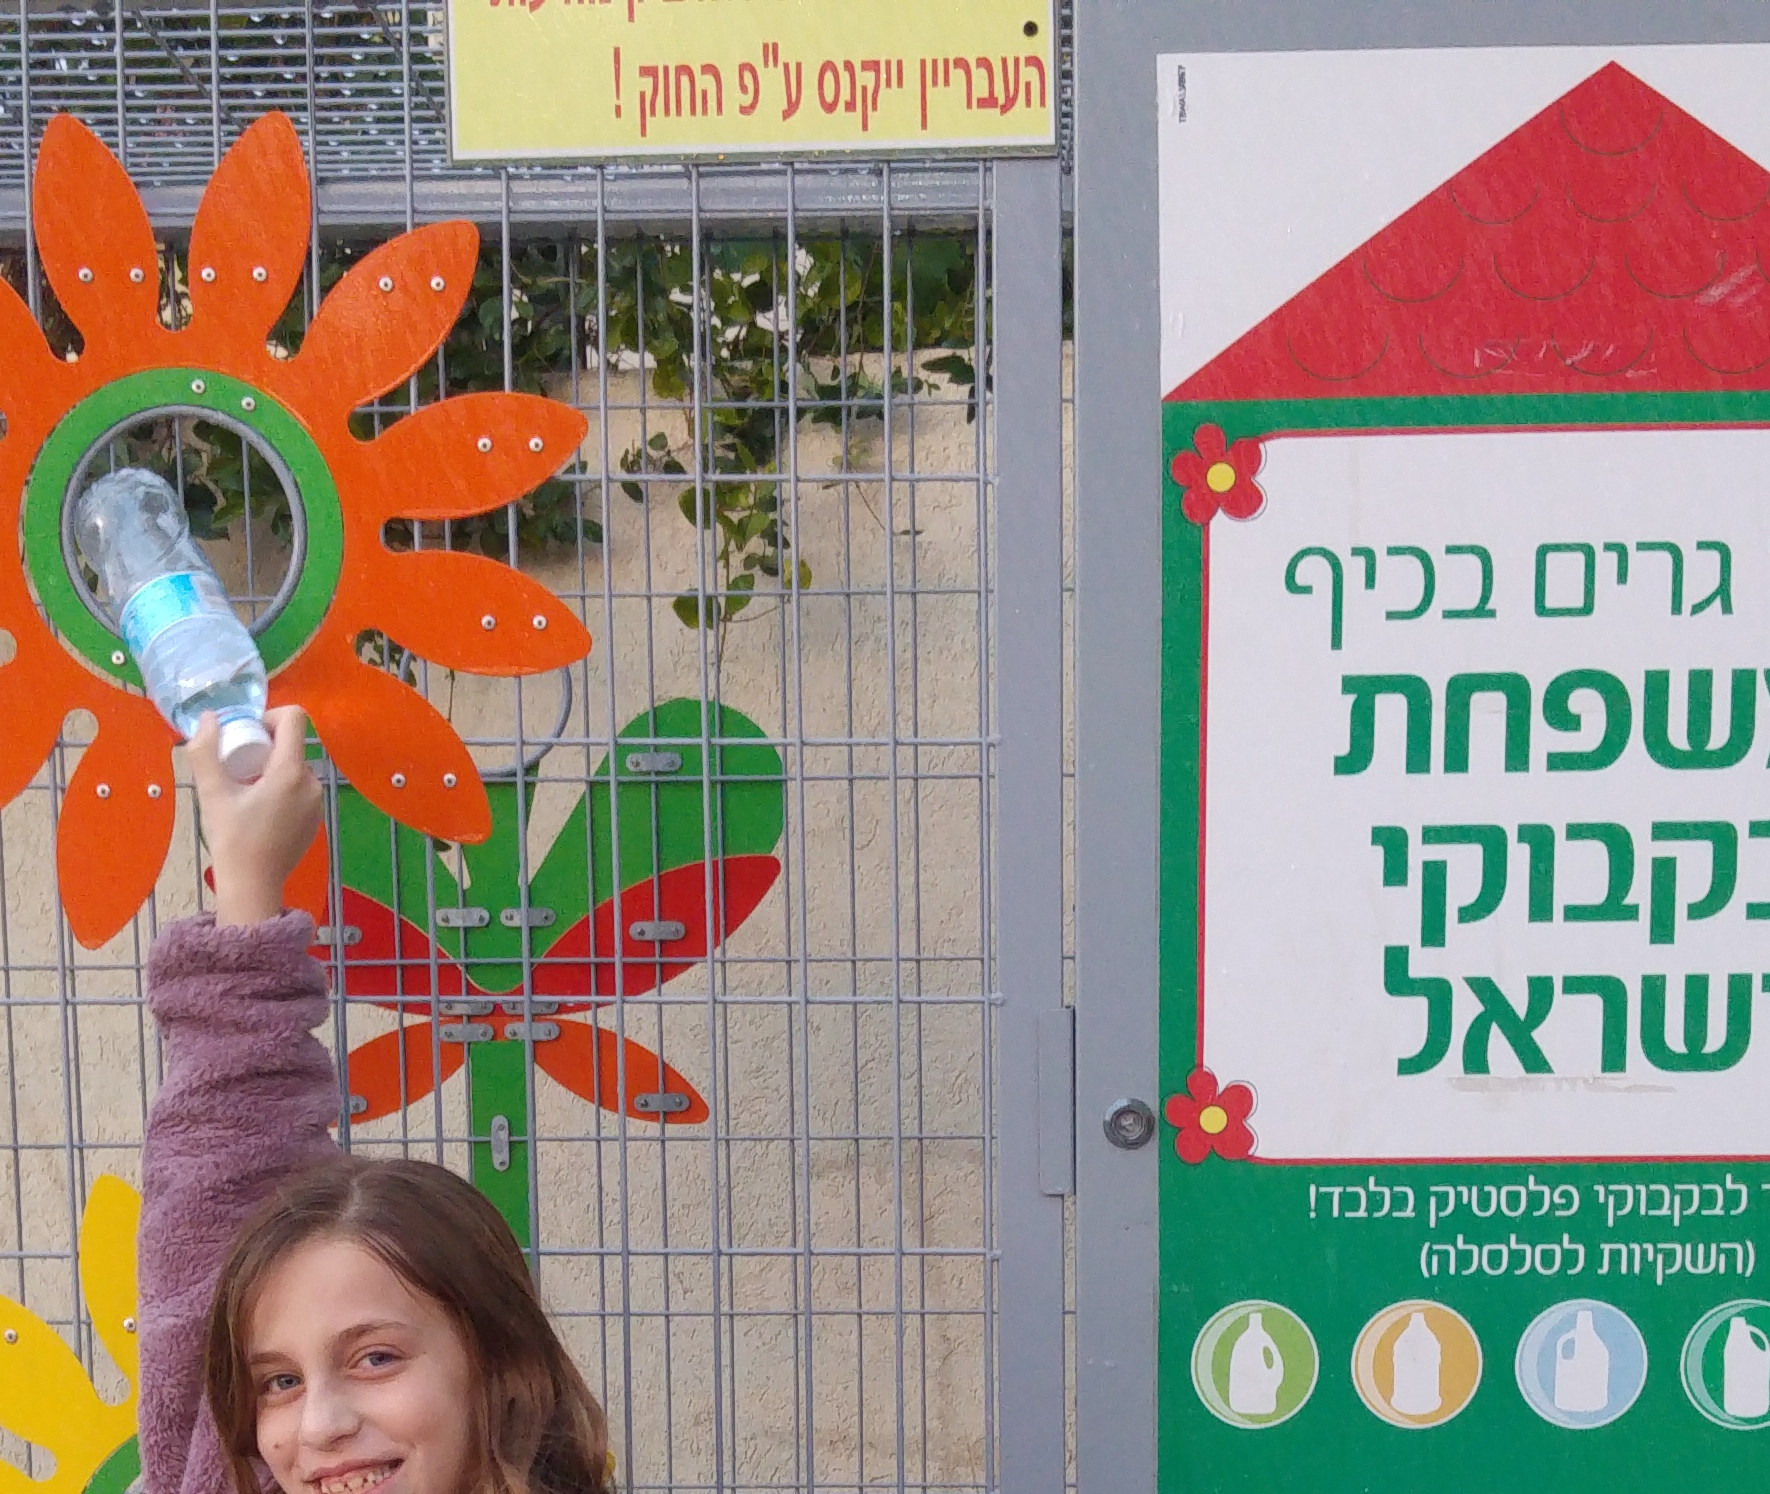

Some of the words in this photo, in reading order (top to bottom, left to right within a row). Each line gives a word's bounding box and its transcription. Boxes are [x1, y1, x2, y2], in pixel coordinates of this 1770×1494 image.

[639, 62, 723, 138] החוק
[738, 41, 802, 121] ע"פ
[817, 59, 904, 132] ייקנס
[920, 55, 1046, 131] העבריין
[1284, 545, 1496, 650] בכיף
[1534, 540, 1733, 618] גרים
[1308, 1176, 1417, 1219] בלבד!
[1429, 1175, 1581, 1228] פלסטיק
[1593, 1173, 1749, 1227] לבקבוקי
[1419, 1232, 1585, 1279] לסלסלה)
[1597, 1239, 1756, 1286] (השקיות
